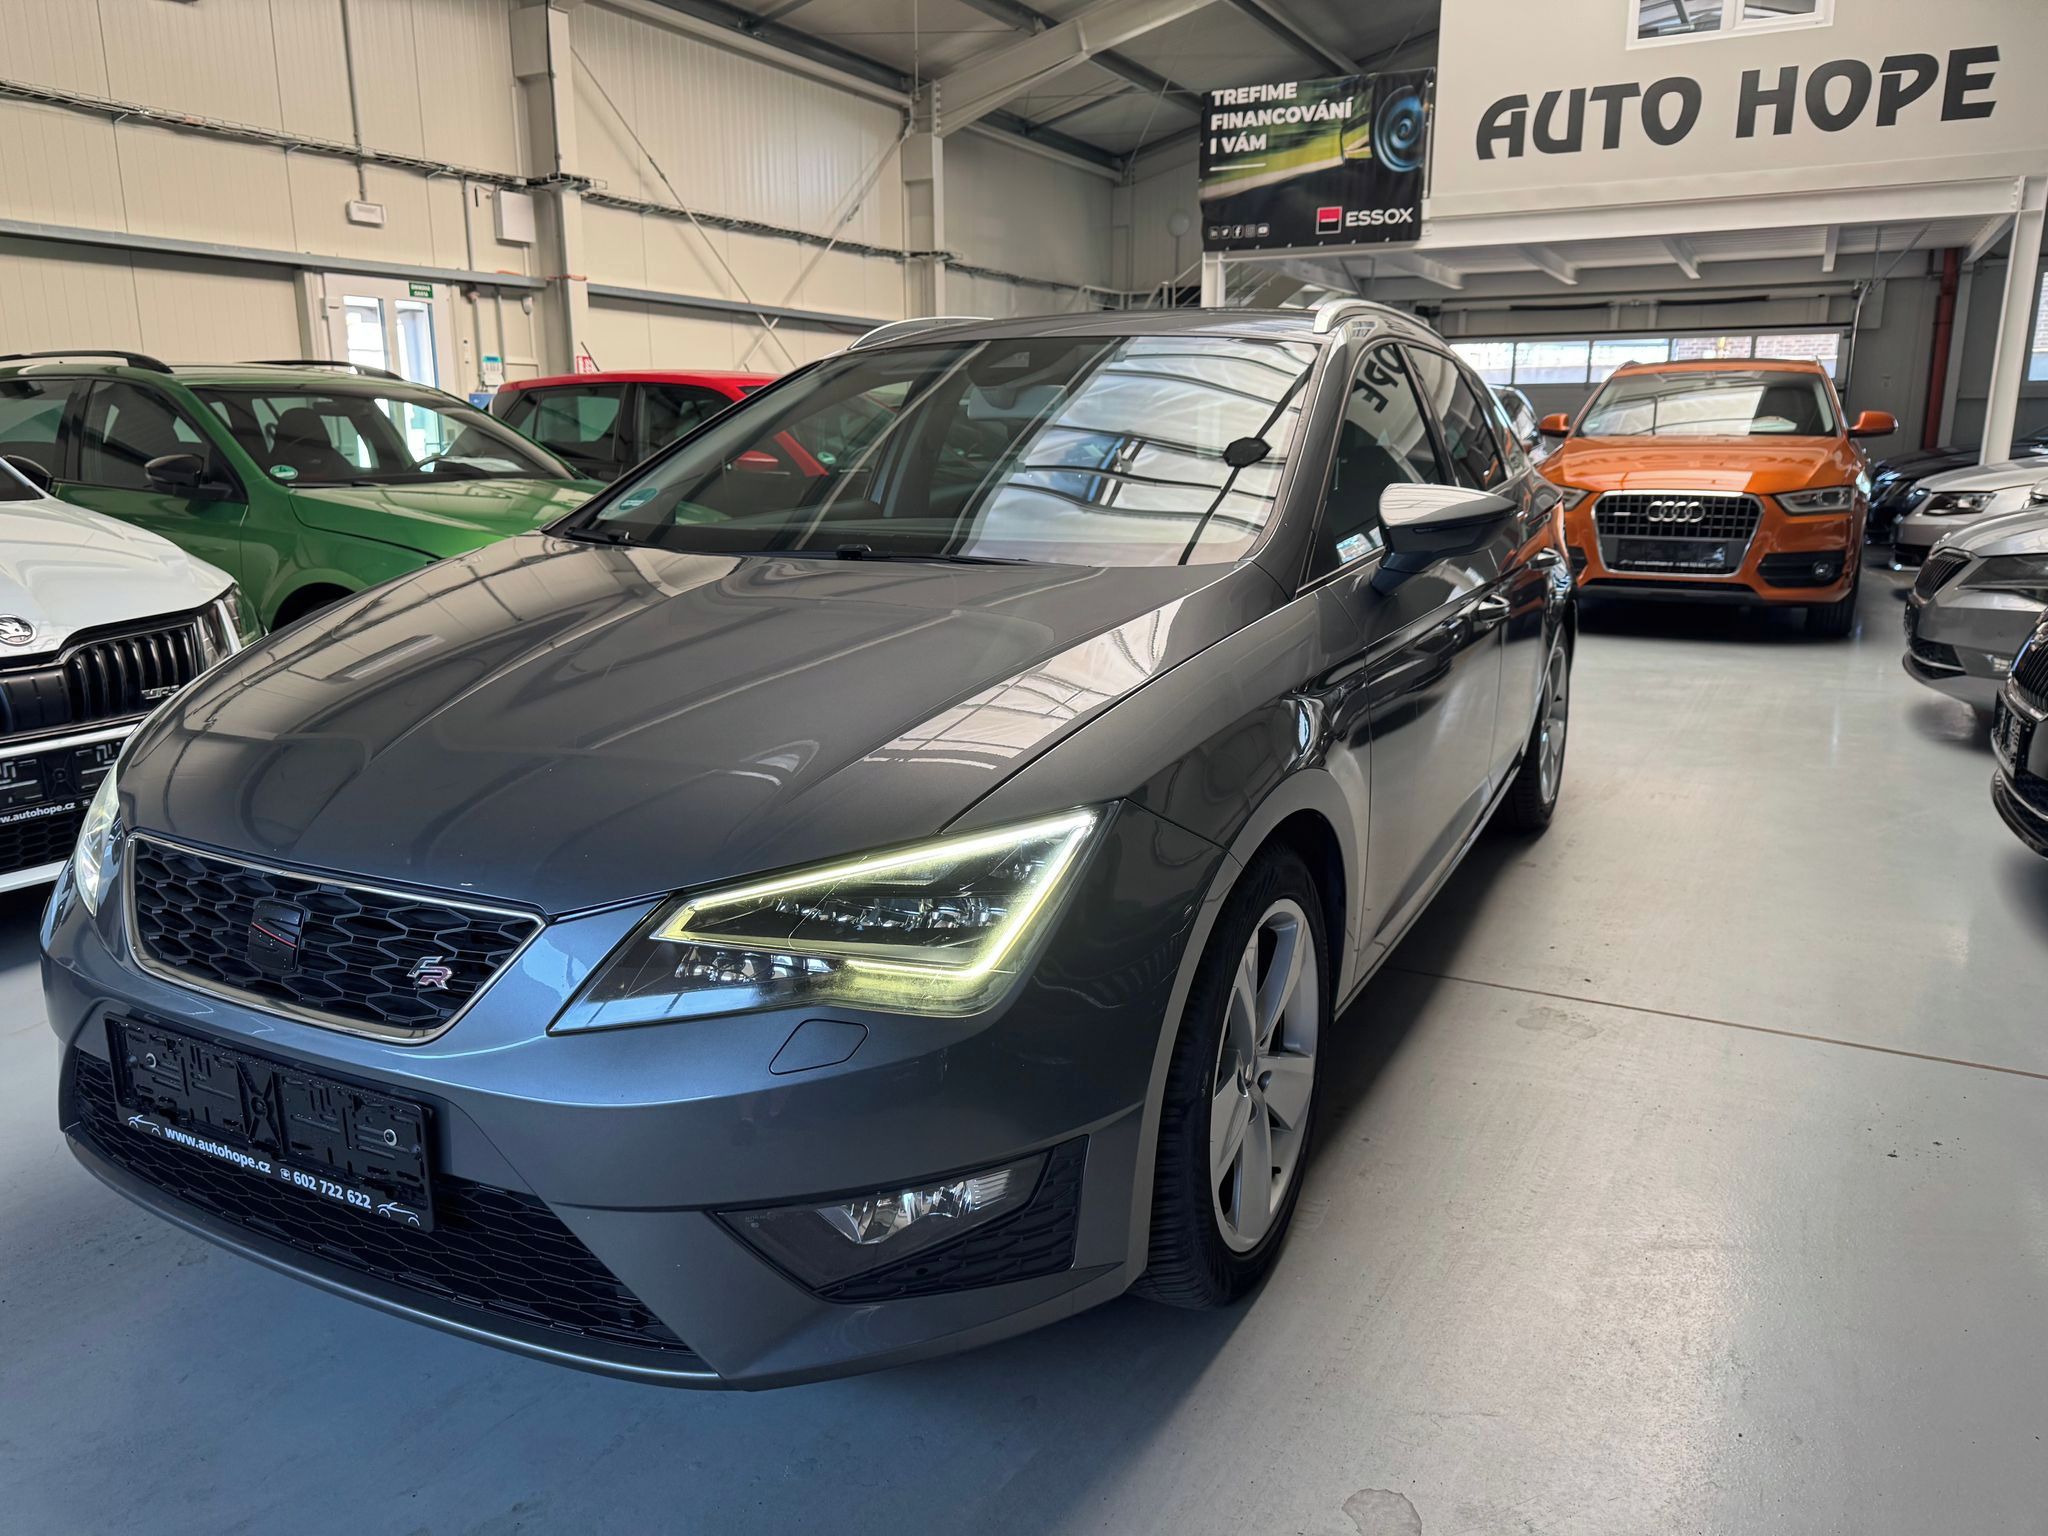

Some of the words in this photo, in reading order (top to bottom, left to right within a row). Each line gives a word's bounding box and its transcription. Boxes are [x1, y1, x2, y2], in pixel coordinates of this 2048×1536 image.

[1211, 81, 1298, 107] TREFIME
[1476, 76, 1702, 160] AUTO
[1735, 45, 2001, 139] HOPE
[1210, 96, 1354, 131] FINANCOVÁNÍ
[1210, 138, 1217, 155] I
[1221, 131, 1267, 154] VÁM
[1345, 207, 1414, 227] ESSOX
[164, 1127, 271, 1174] www.autohope.cz
[293, 1171, 317, 1191] 602
[319, 1180, 344, 1200] 722
[347, 1189, 372, 1209] 622
